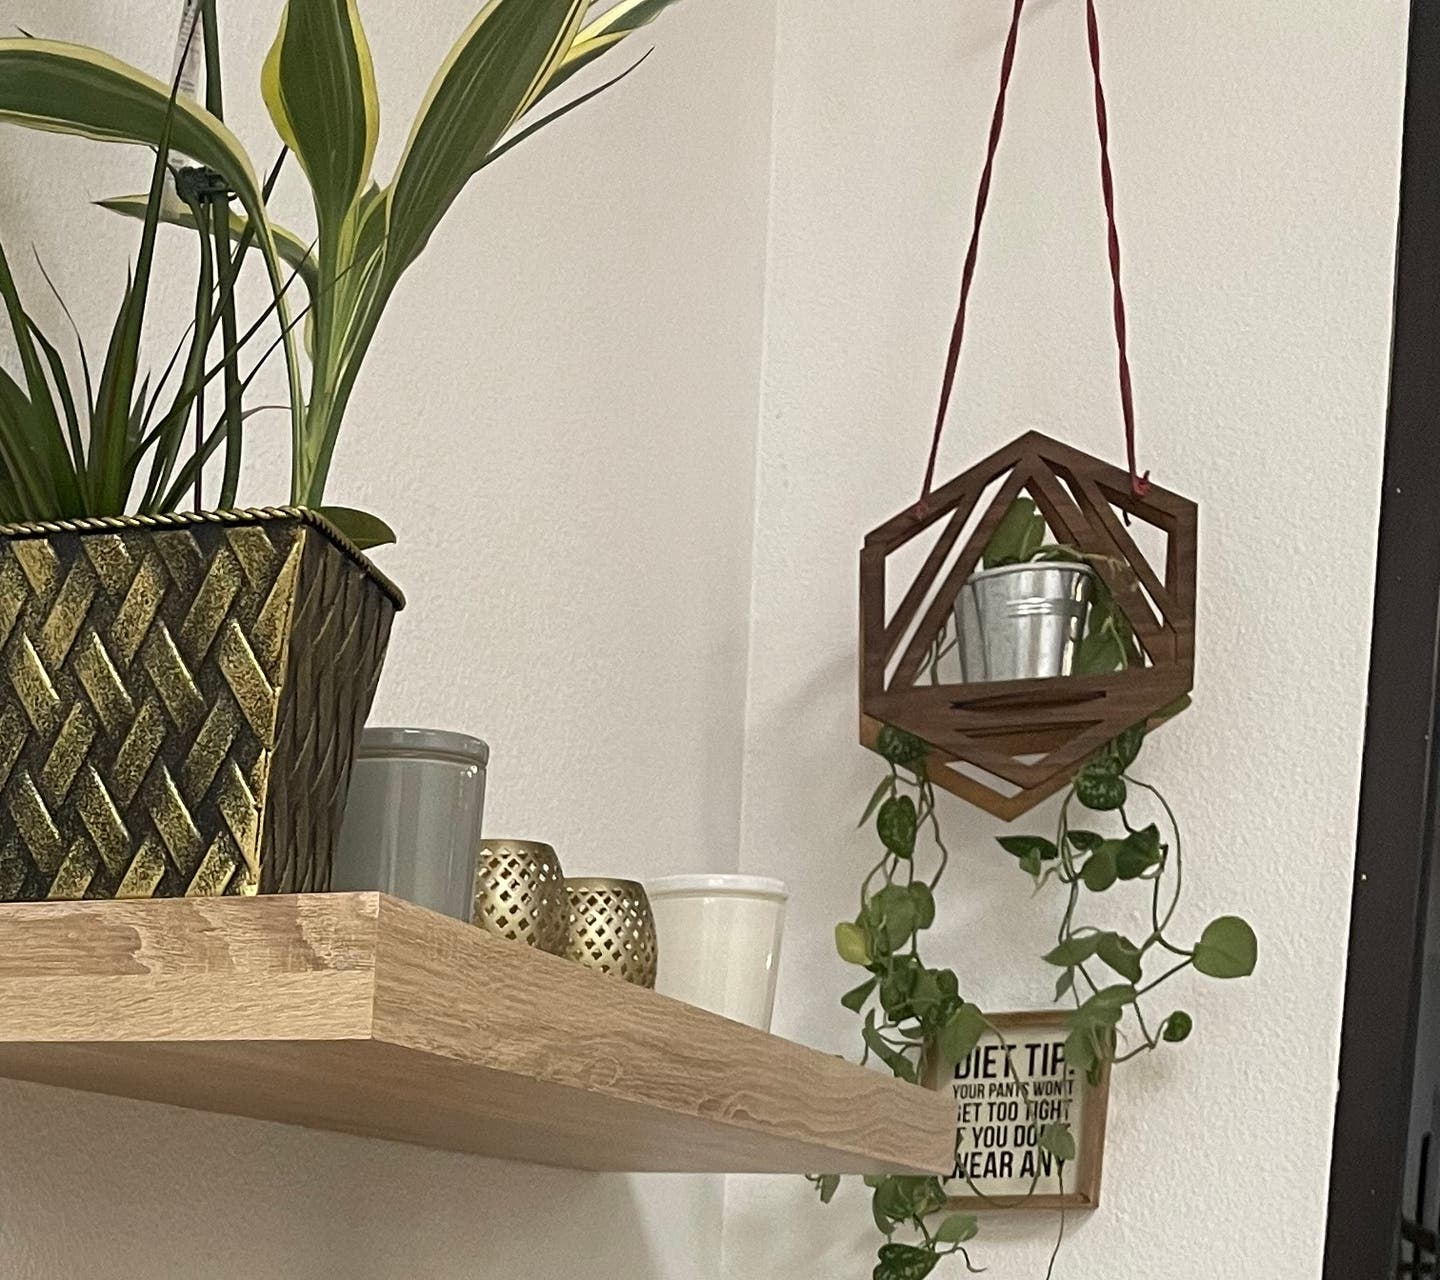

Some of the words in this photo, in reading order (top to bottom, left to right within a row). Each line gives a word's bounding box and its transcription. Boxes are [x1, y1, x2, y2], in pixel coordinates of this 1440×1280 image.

[952, 1083, 986, 1099] YOUR
[957, 1102, 983, 1123] ET
[987, 1101, 1019, 1122] TOO
[972, 1125, 1008, 1149] YOU
